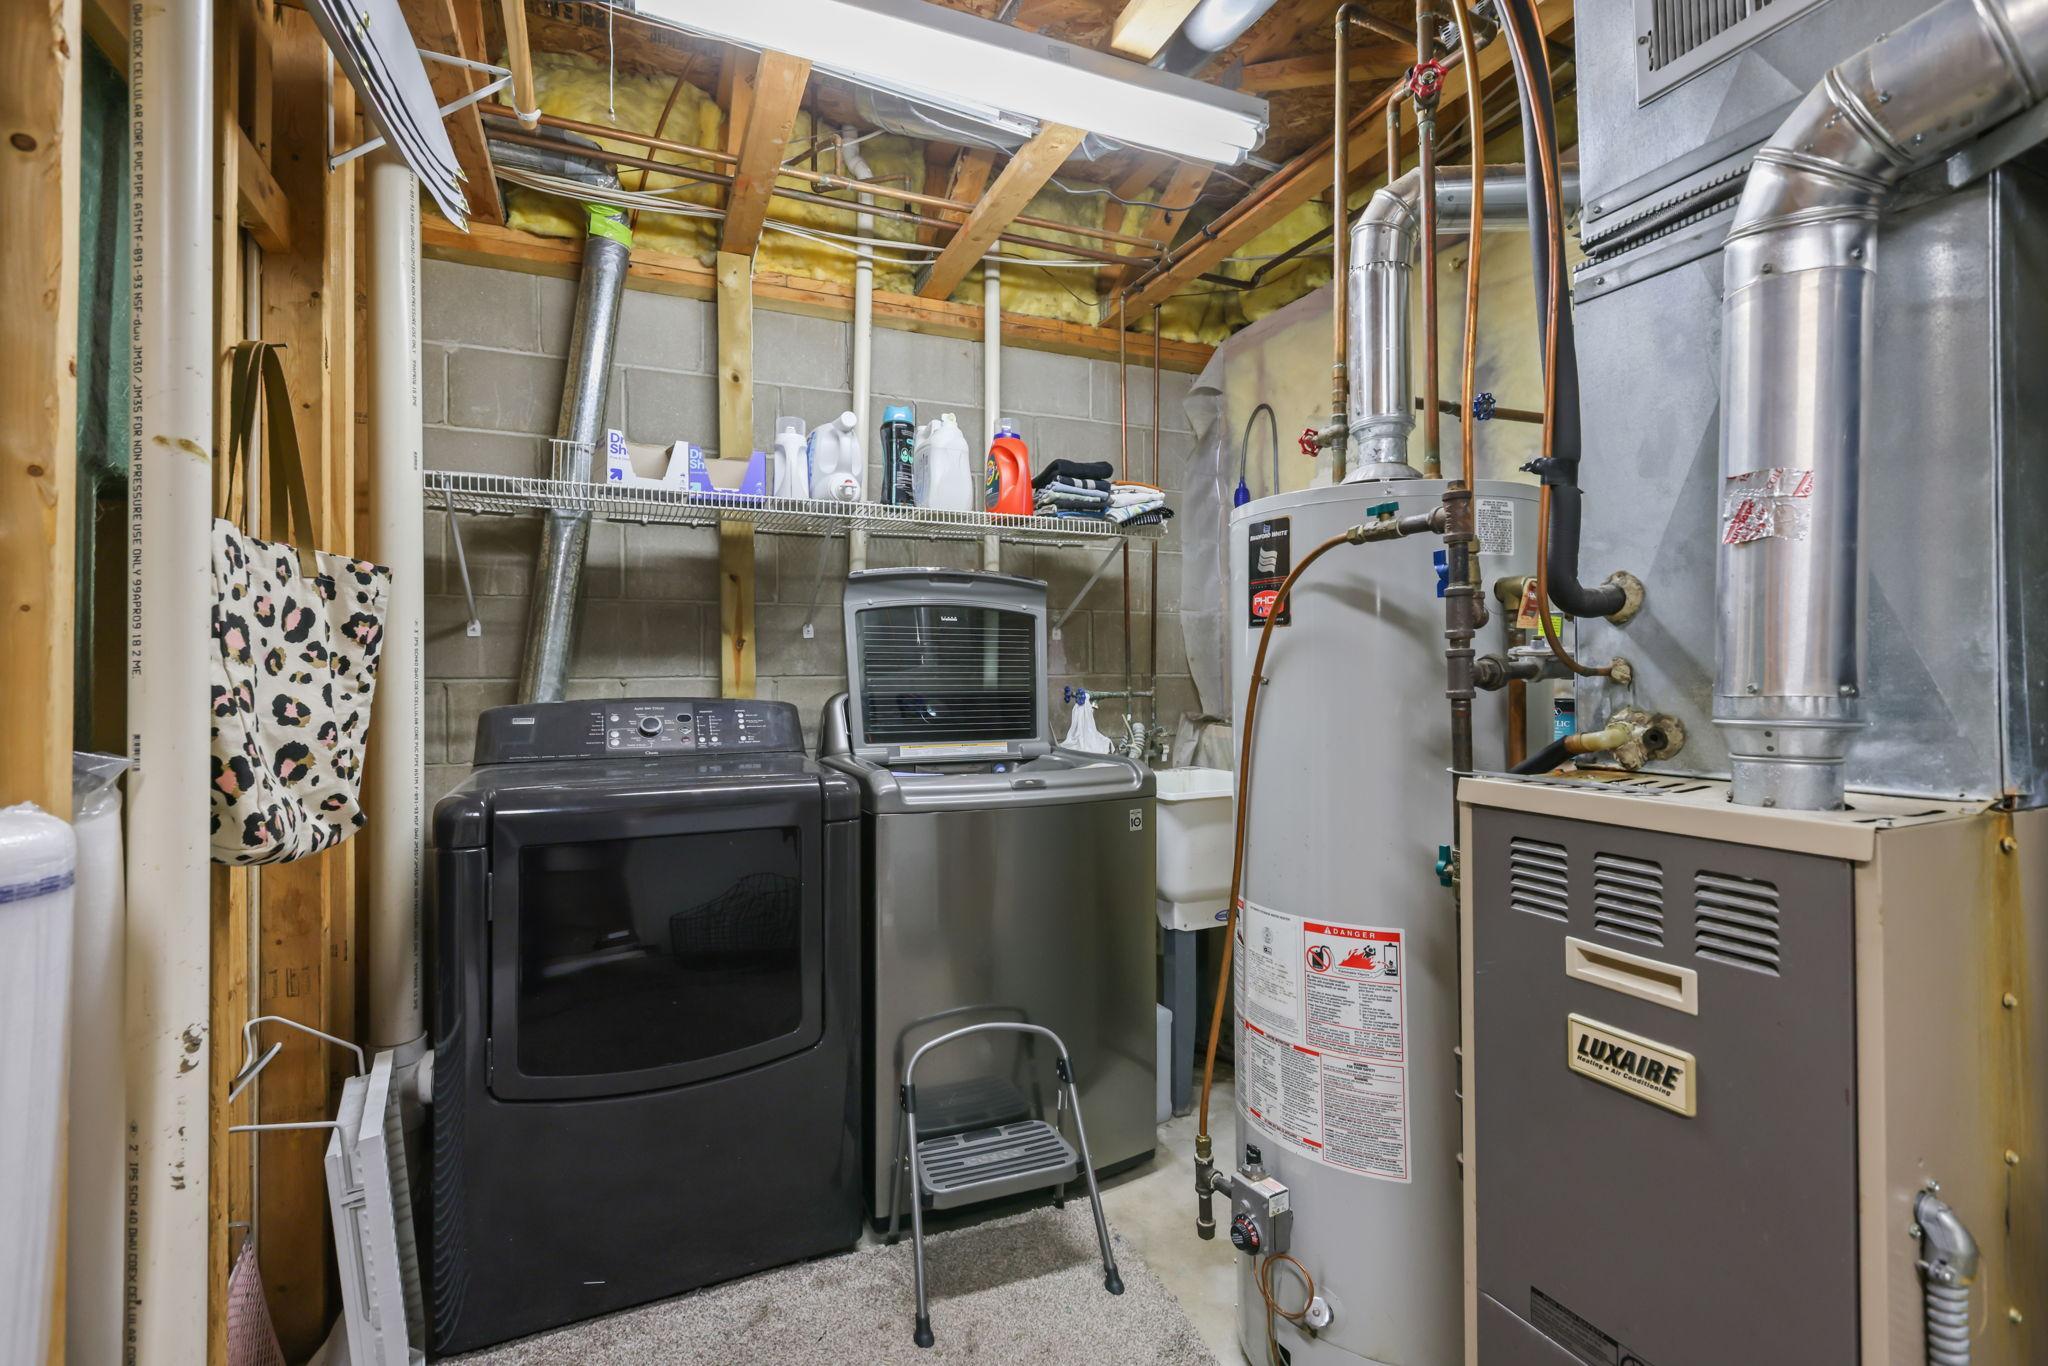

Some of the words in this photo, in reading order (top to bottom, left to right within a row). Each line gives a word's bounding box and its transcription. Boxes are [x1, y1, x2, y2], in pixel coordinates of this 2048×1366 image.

[133, 61, 143, 118] CELLULAR
[133, 121, 143, 148] CORE
[133, 174, 143, 199] PIPE
[133, 203, 143, 235] ASTM
[133, 235, 143, 289] F-891-93
[133, 416, 143, 437] FOR
[133, 440, 143, 461] NON
[609, 444, 628, 455] Sh
[133, 464, 143, 520] PRESSURE
[132, 524, 142, 545] USE
[1271, 529, 1288, 538] WHITE
[132, 549, 142, 576] ONLY
[1333, 927, 1376, 939] DANGER
[1577, 1033, 1680, 1091] LUXAIRE
[1577, 1055, 1603, 1070] Heating
[1610, 1067, 1622, 1076] Air
[1623, 1073, 1671, 1097] Conditioning
[128, 1162, 139, 1182] IPS
[128, 1184, 139, 1207] SCH
[127, 1346, 138, 1366] COR
